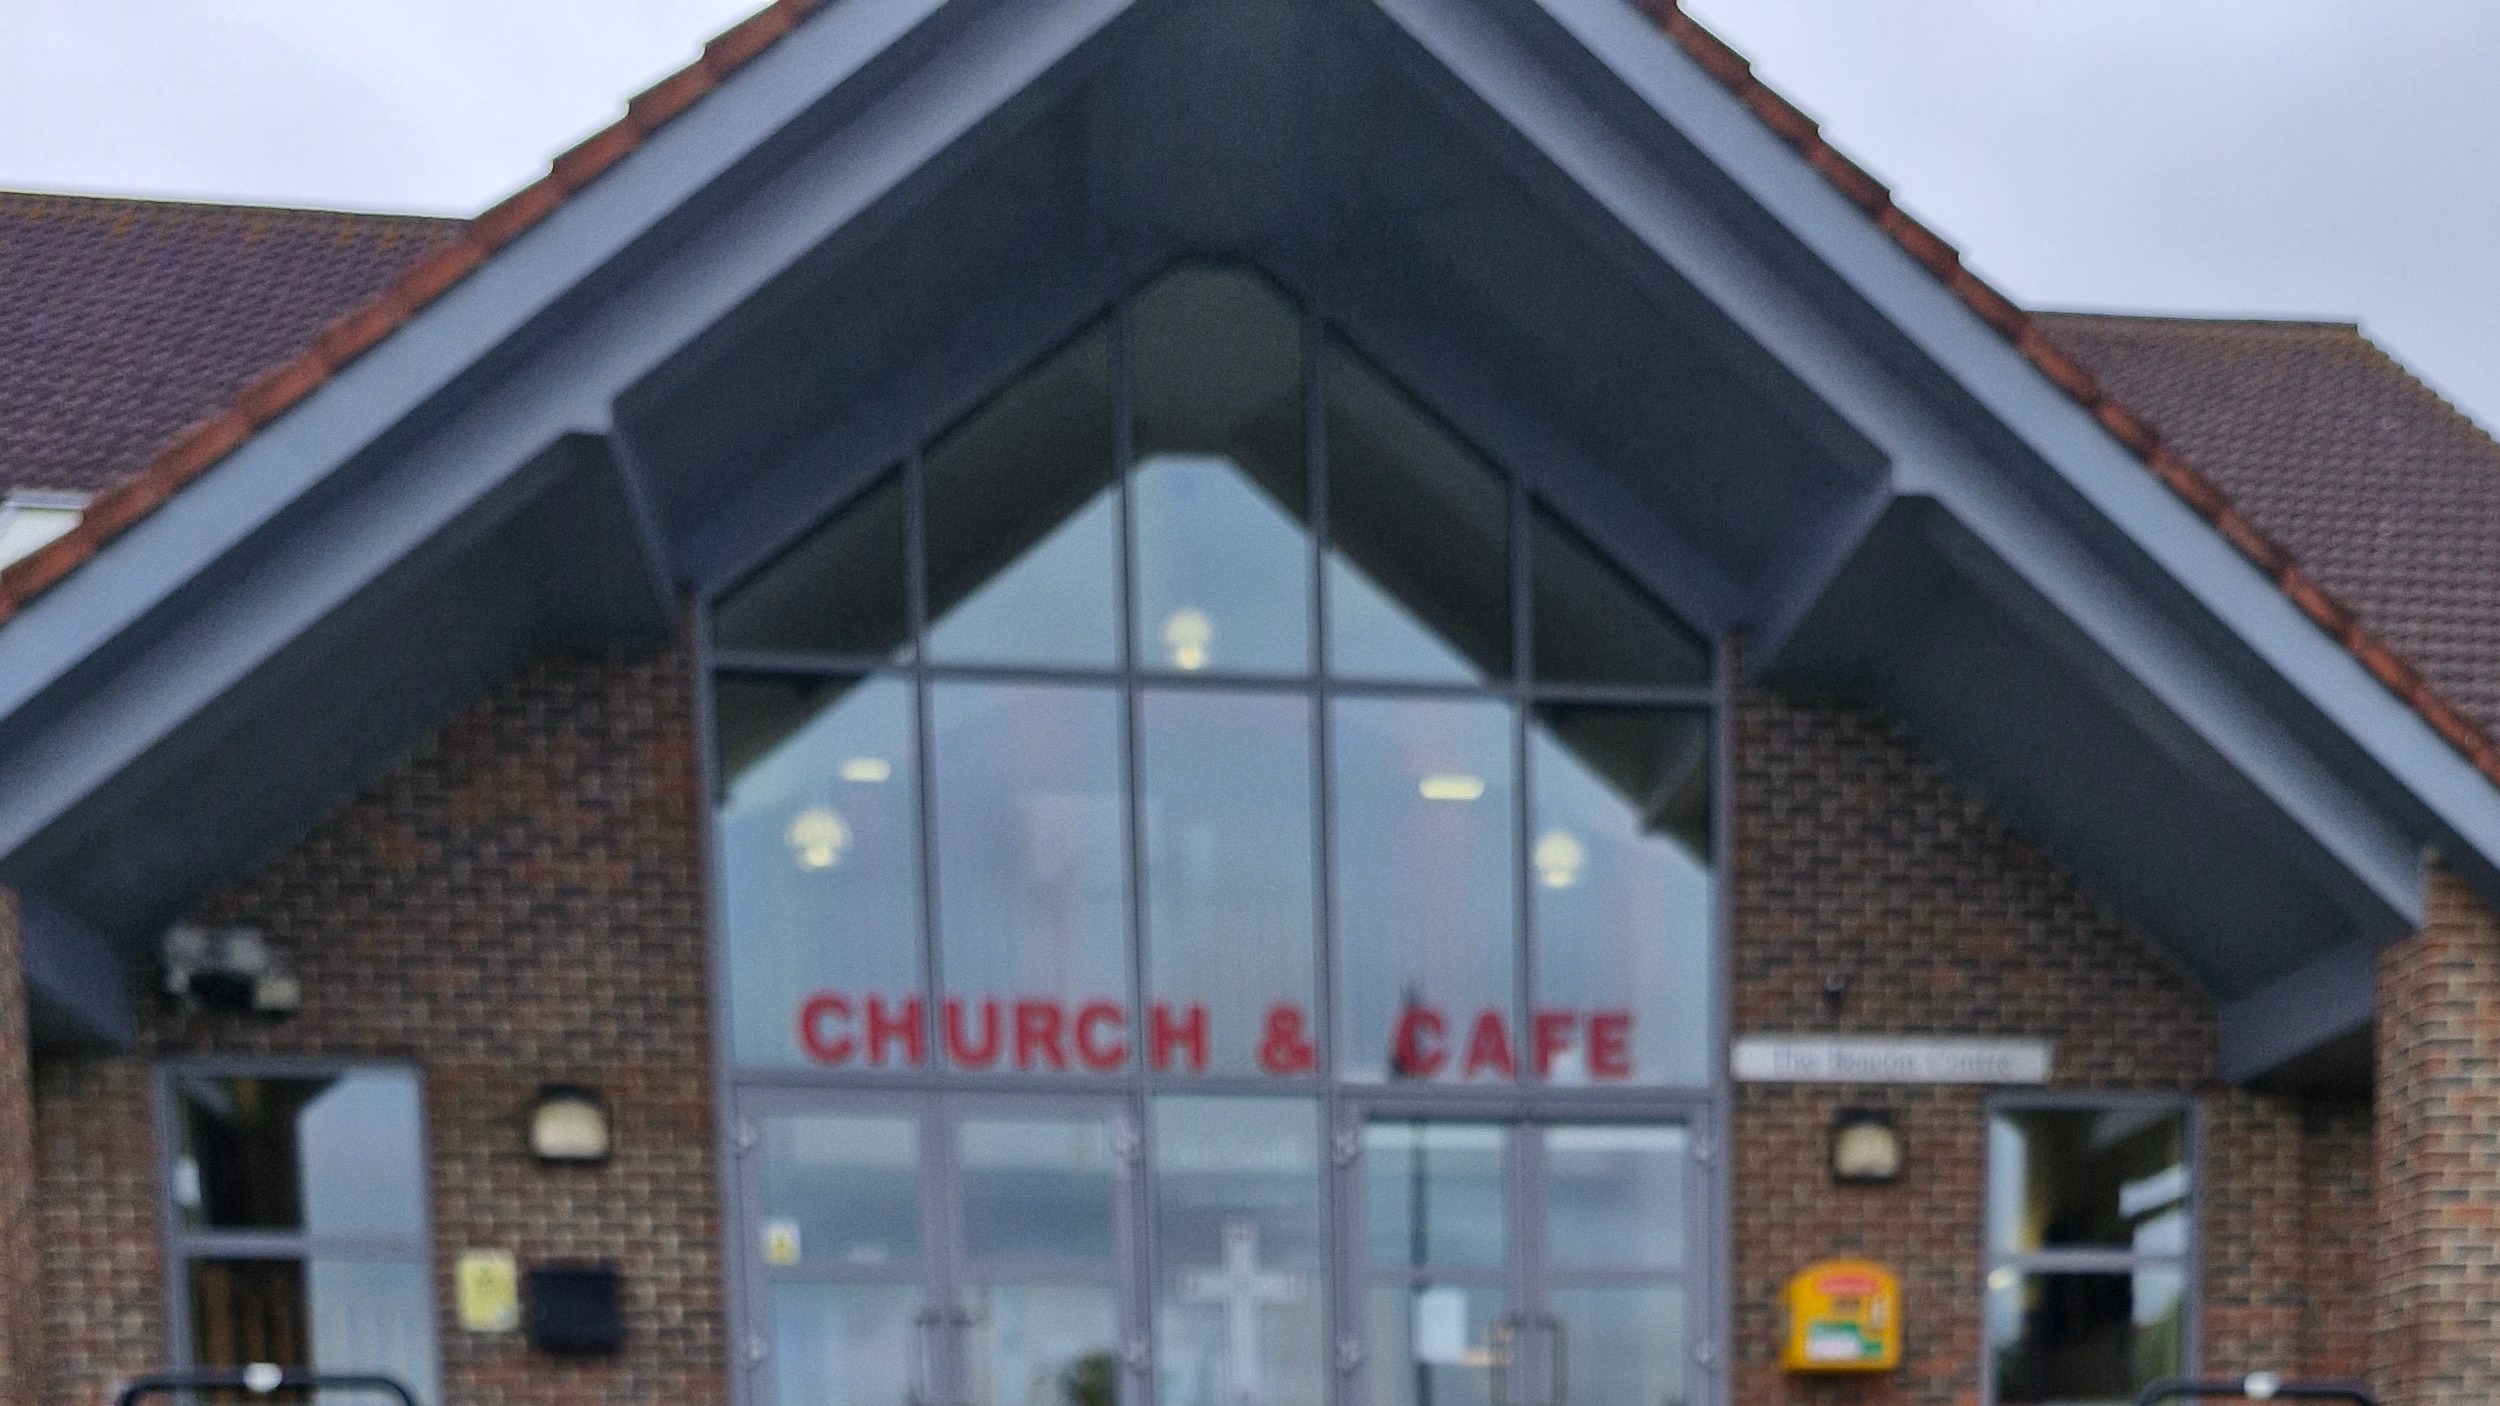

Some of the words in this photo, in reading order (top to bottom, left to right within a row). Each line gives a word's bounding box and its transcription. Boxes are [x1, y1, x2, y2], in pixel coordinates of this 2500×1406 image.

[797, 995, 1208, 1072] CHURCH
[1257, 1006, 1316, 1075] &
[1394, 1008, 1635, 1079] CAFE
